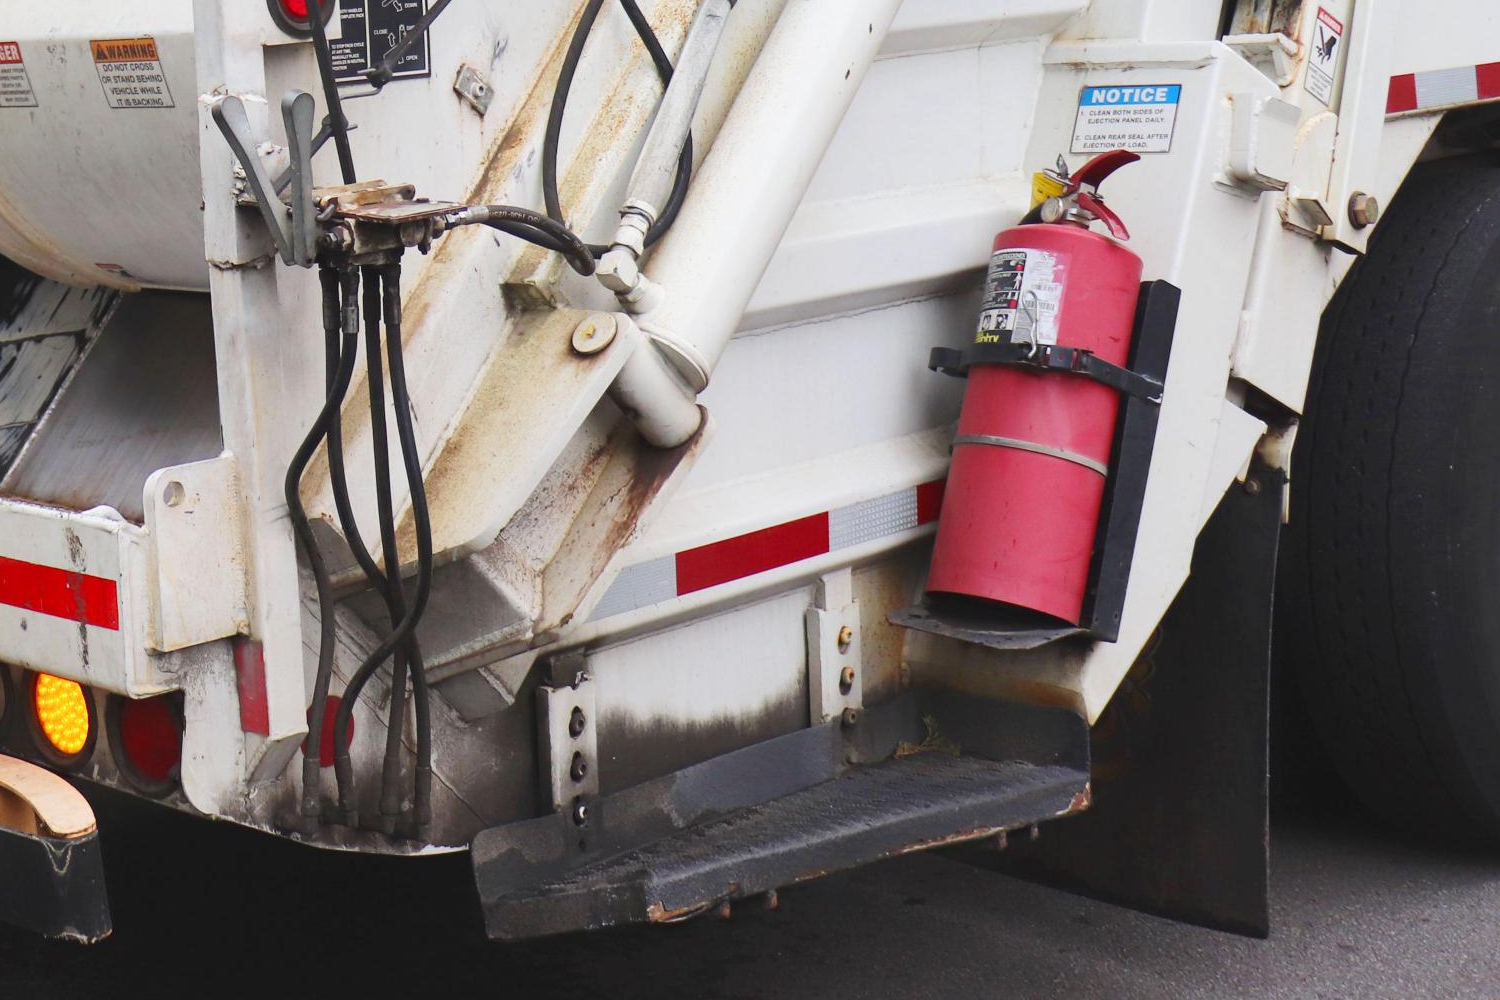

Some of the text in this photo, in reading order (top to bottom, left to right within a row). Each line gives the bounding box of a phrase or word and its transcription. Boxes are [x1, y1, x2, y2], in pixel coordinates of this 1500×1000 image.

[106, 44, 156, 59] WARNING
[102, 63, 154, 72] DO NOT CROSS
[102, 74, 163, 84] OR STAND BEHIND
[110, 86, 162, 95] VEHICLE WHILE
[1092, 88, 1168, 104] NOTICE
